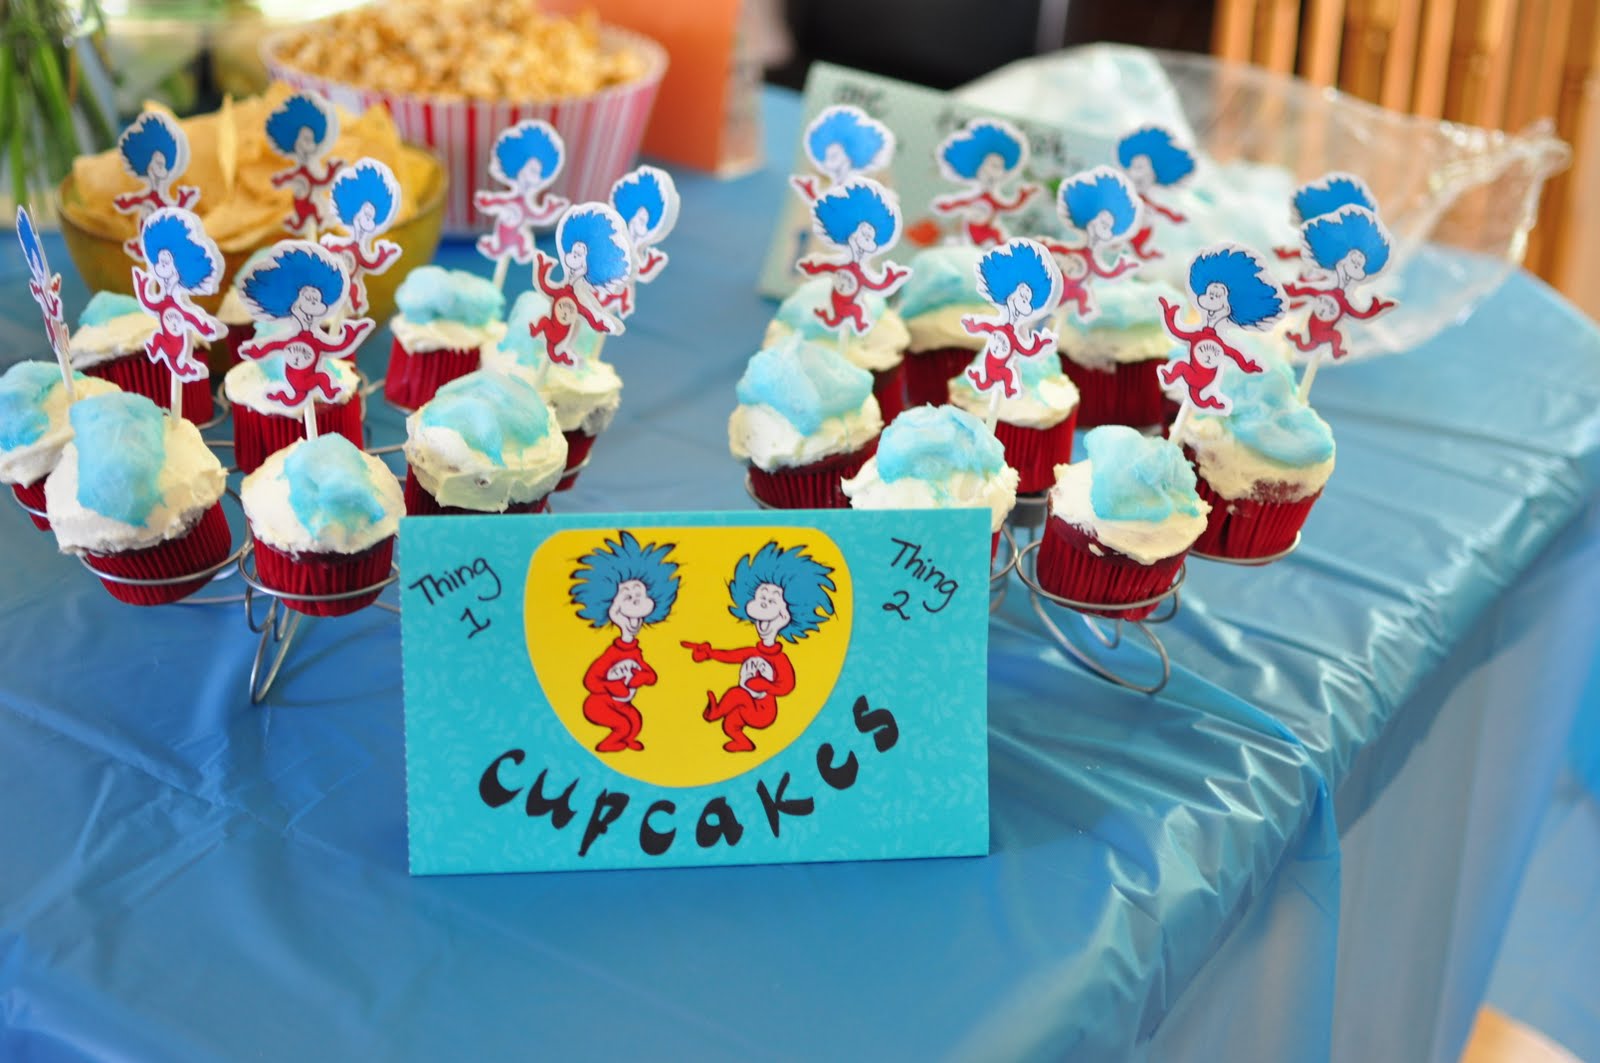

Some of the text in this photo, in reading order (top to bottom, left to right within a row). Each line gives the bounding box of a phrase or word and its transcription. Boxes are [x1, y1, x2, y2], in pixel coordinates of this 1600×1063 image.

[1198, 343, 1220, 357] THING
[1205, 355, 1211, 365] 2
[408, 557, 502, 606] Thing
[890, 537, 959, 614] Thing
[882, 590, 911, 621] 2
[460, 607, 491, 639] 1
